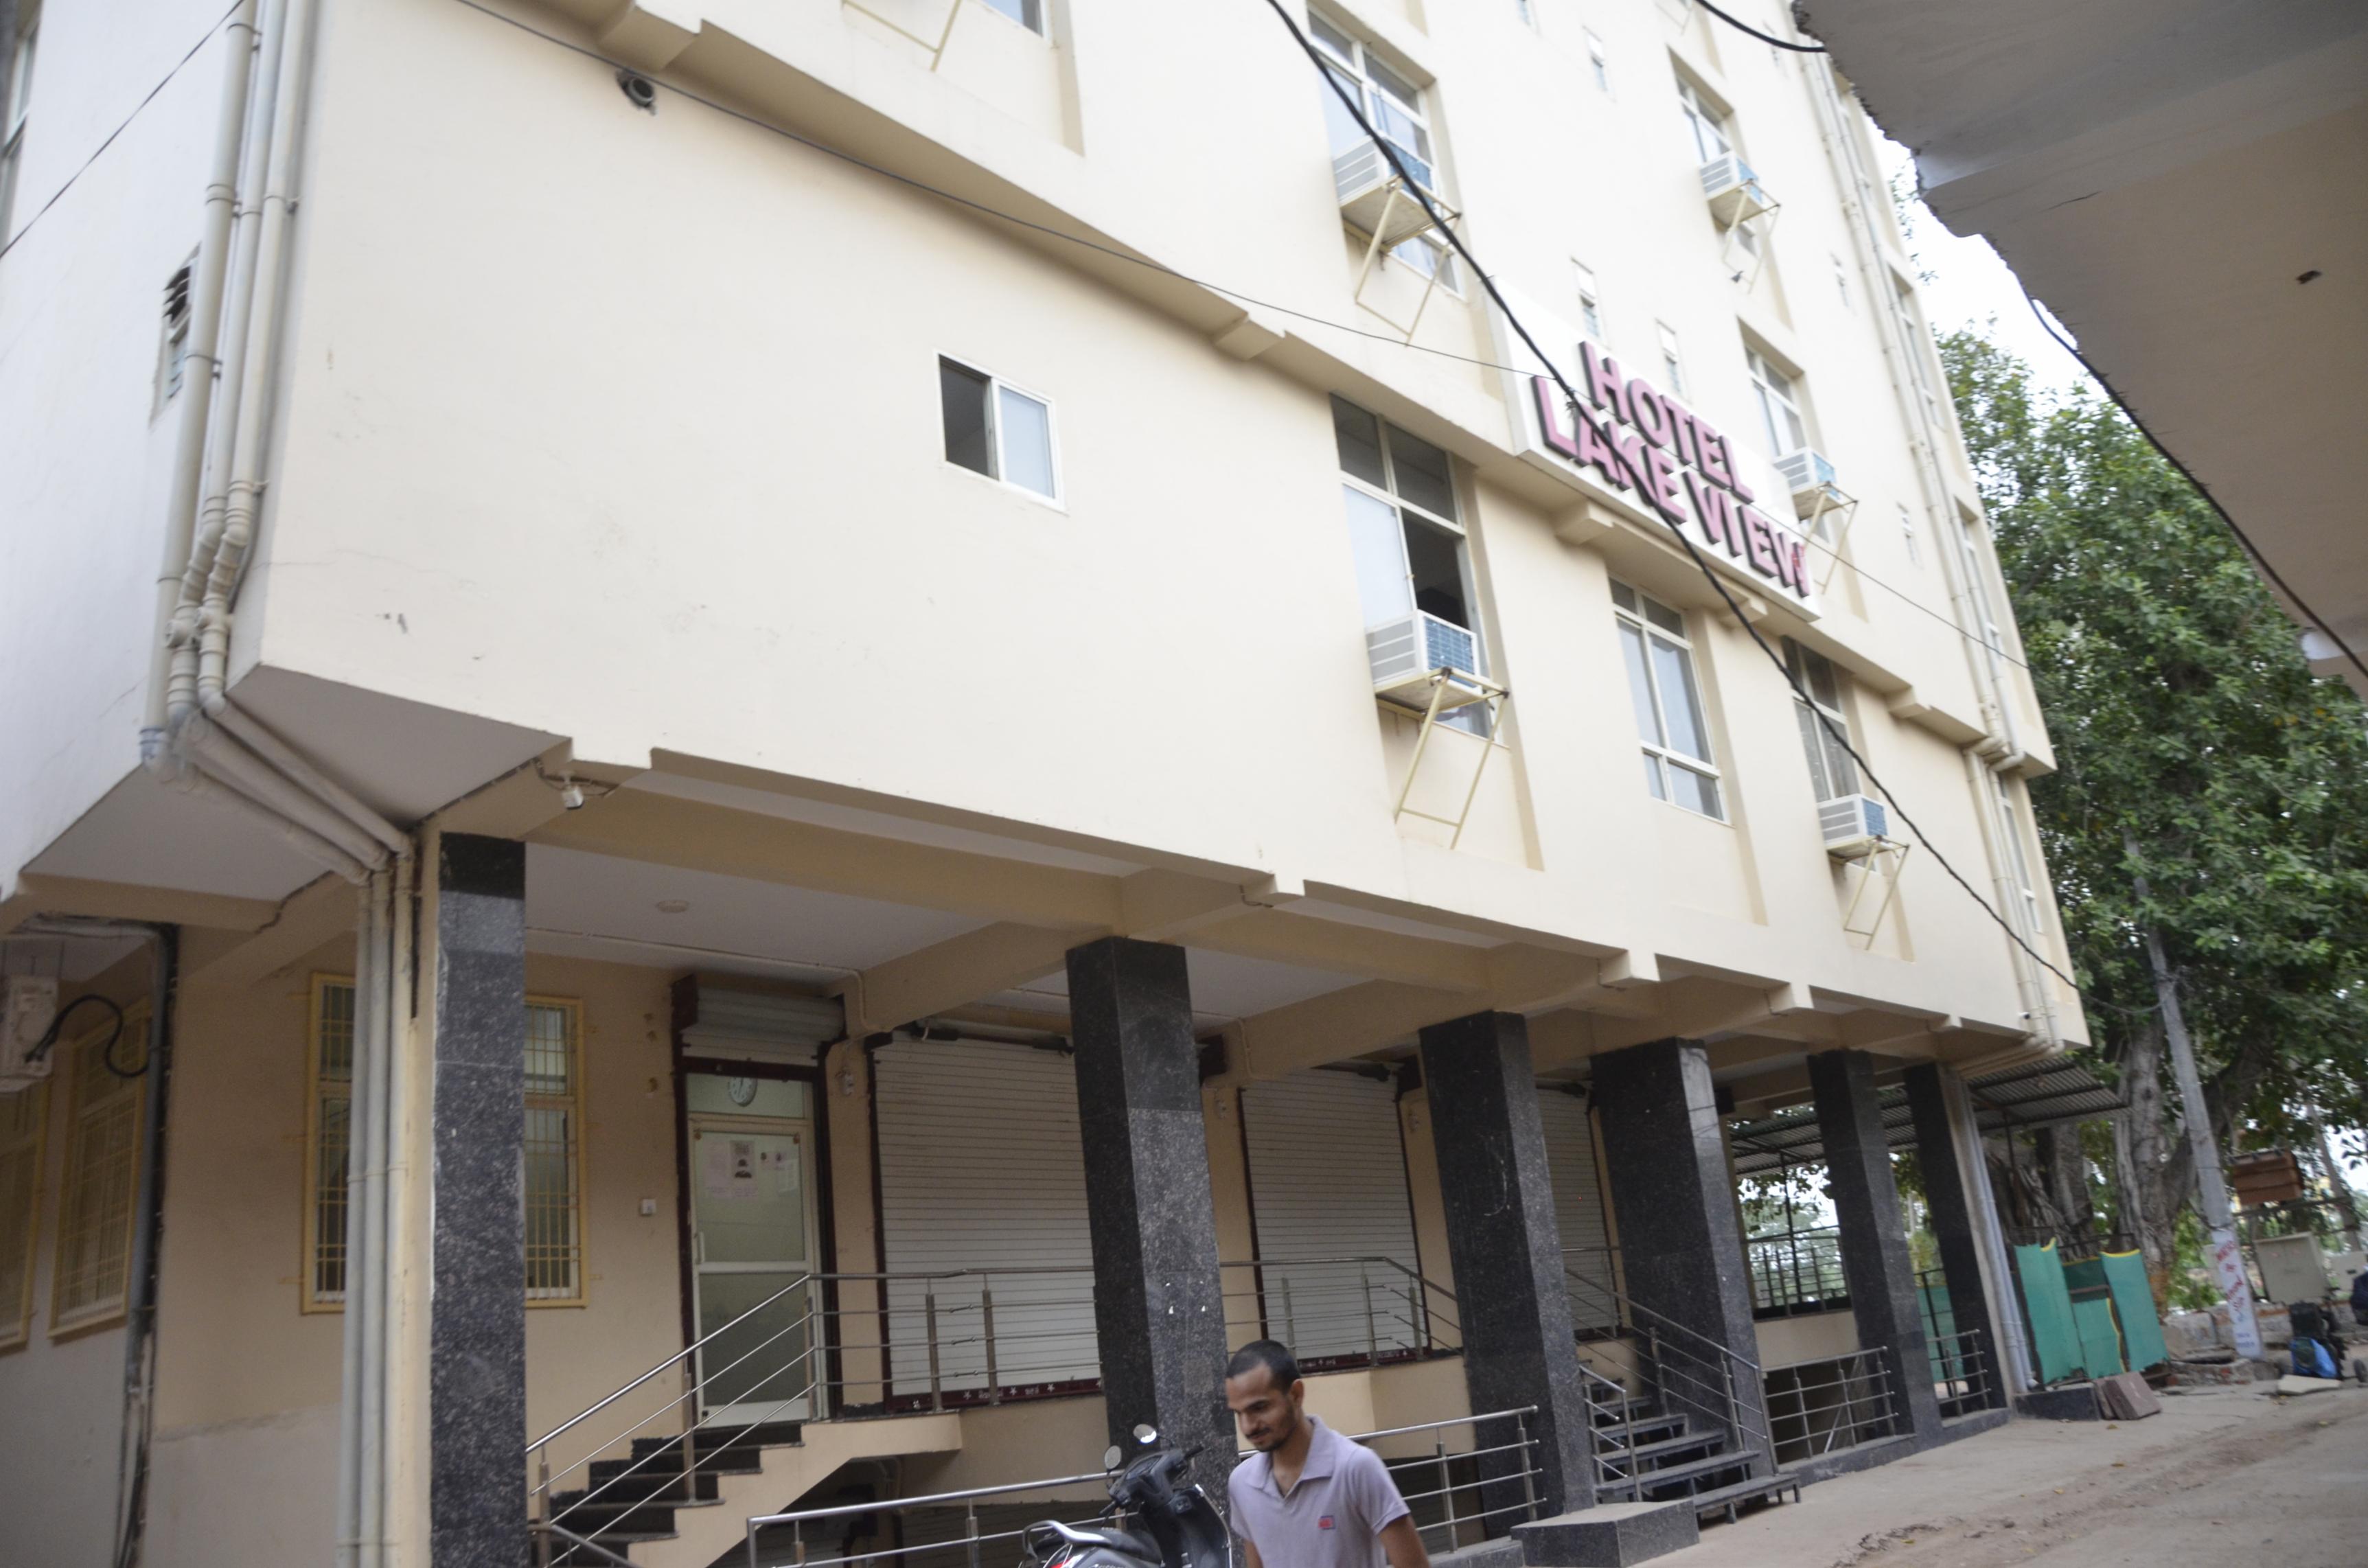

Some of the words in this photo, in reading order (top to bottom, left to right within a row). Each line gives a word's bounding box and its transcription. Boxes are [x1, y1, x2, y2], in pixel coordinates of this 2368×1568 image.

[1531, 376, 1687, 524] LAKE
[1682, 471, 1810, 598] VIEW
[1578, 341, 1754, 505] HOTEL
